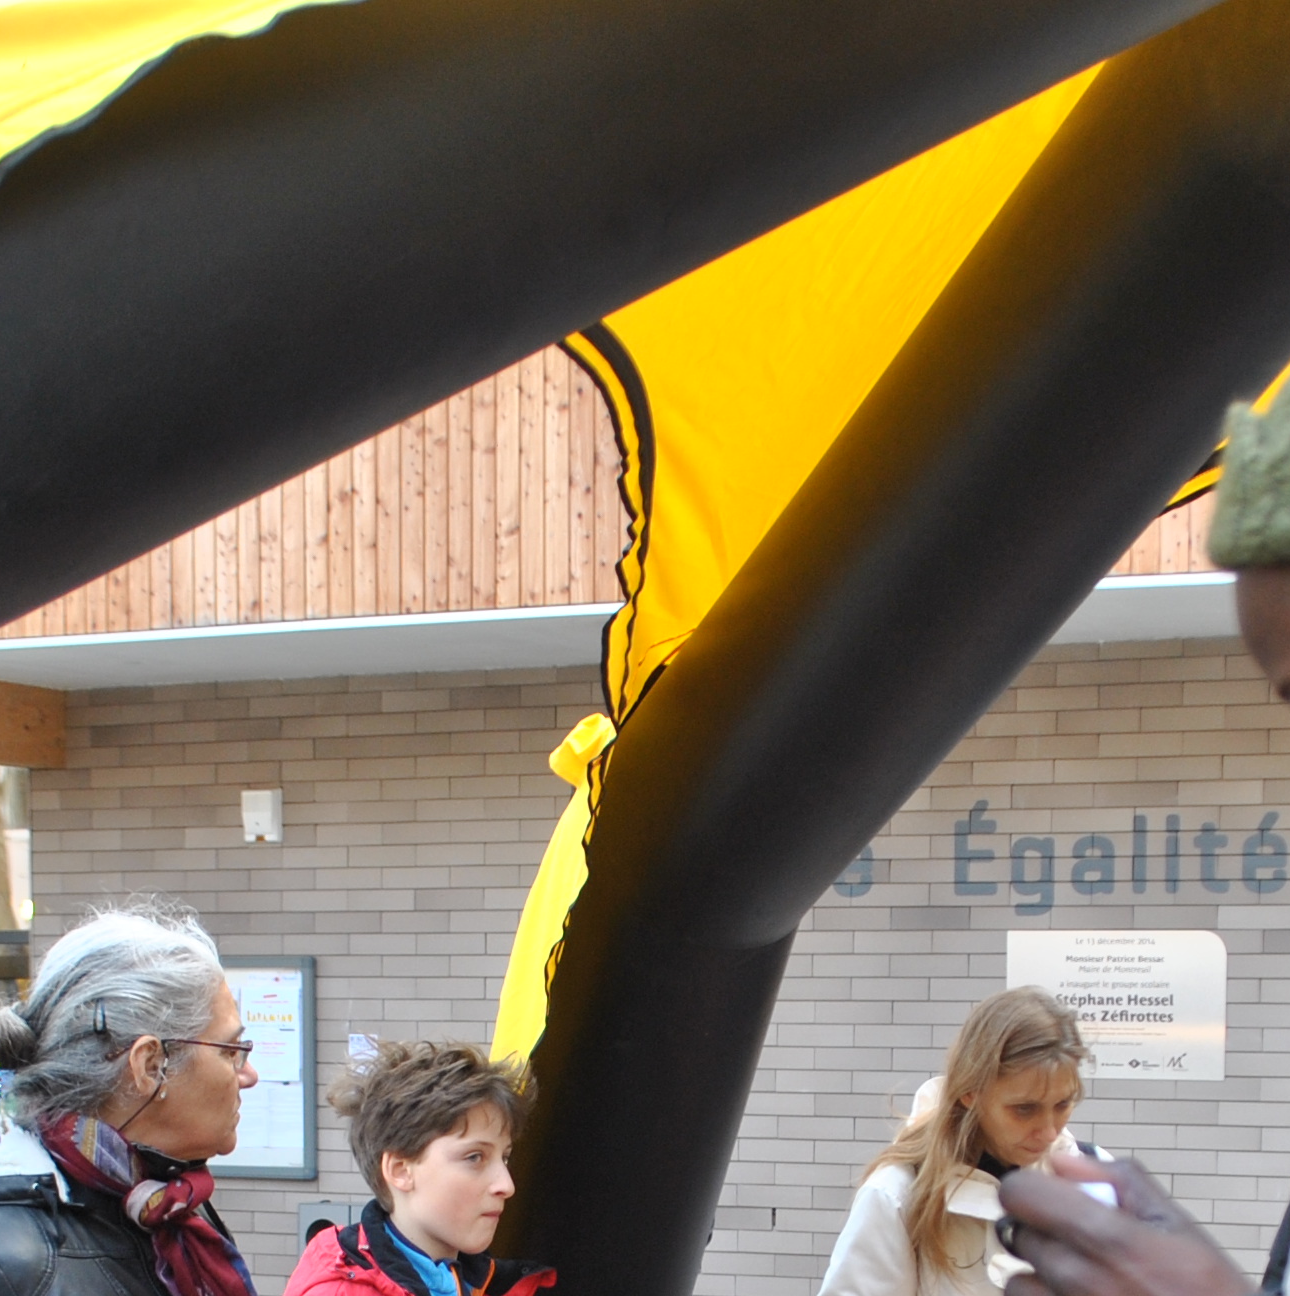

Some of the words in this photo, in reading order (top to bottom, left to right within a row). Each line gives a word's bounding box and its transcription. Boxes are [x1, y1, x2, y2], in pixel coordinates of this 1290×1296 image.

[953, 800, 1289, 917] Égalité
[1075, 937, 1085, 945] Le
[1097, 937, 1136, 945] décembre
[1065, 955, 1104, 963] Monsieur
[1106, 955, 1136, 963] Patrice
[1138, 955, 1165, 963] Bessac
[1113, 965, 1152, 973] Montreuil
[1066, 980, 1100, 990] inauguré
[1102, 980, 1110, 988] le
[1111, 982, 1139, 990] groupe
[1140, 980, 1170, 988] scolaire
[1055, 993, 1123, 1008] Stéphane
[1127, 993, 1174, 1006] Hessel
[1100, 1009, 1174, 1023] Zéfirottes
